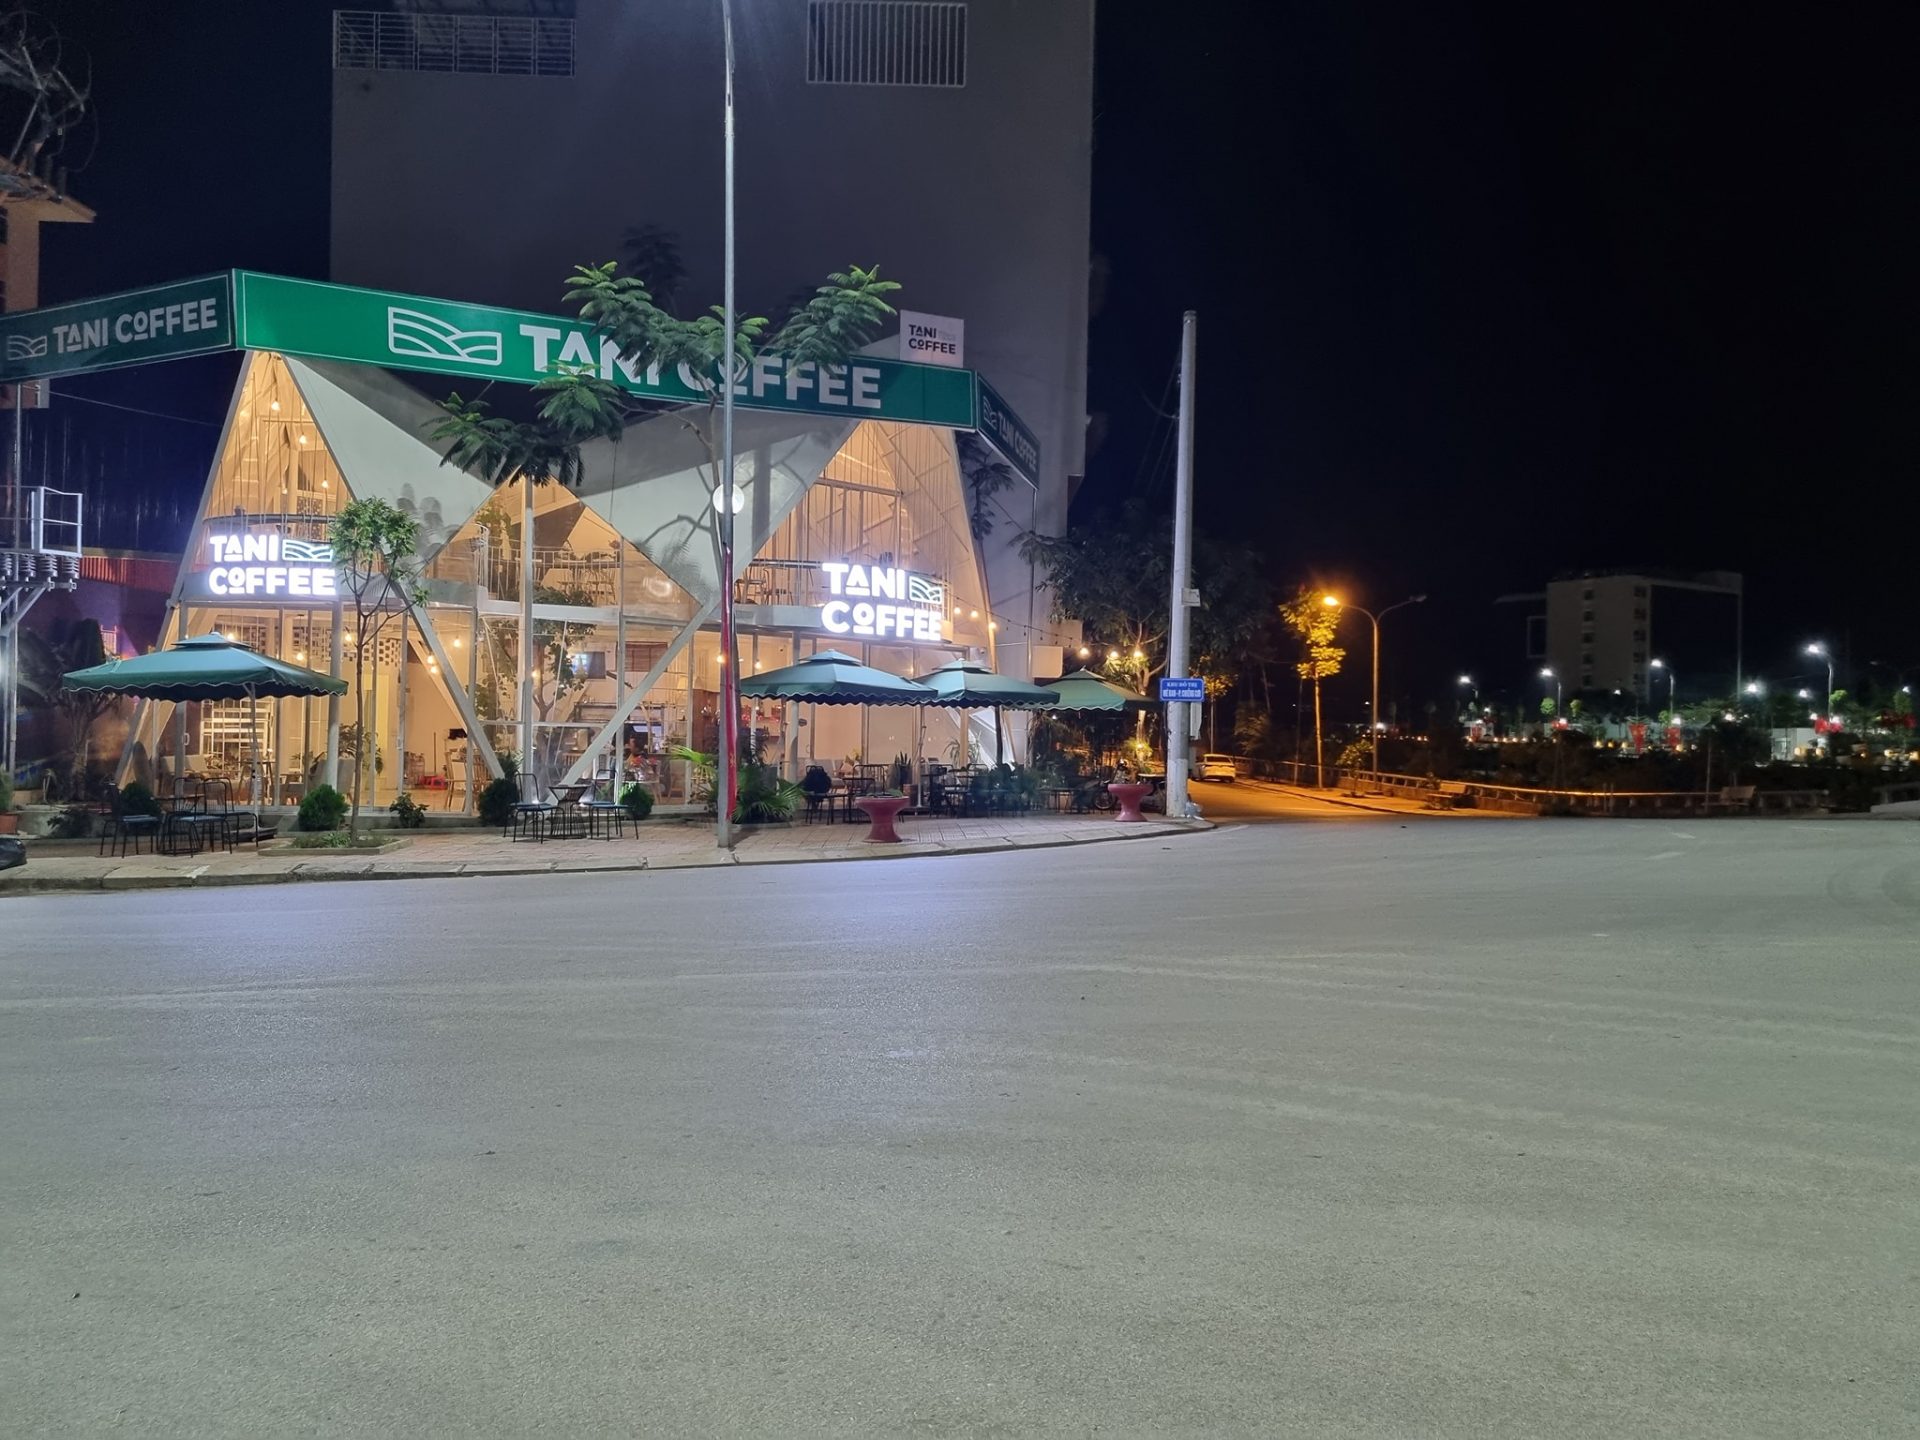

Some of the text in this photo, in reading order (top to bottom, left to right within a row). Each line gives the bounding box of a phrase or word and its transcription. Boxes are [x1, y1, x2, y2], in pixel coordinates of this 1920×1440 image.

[52, 317, 109, 354] TANI
[908, 324, 937, 338] TANI
[209, 534, 279, 563] TANI
[821, 562, 906, 600] TANI
